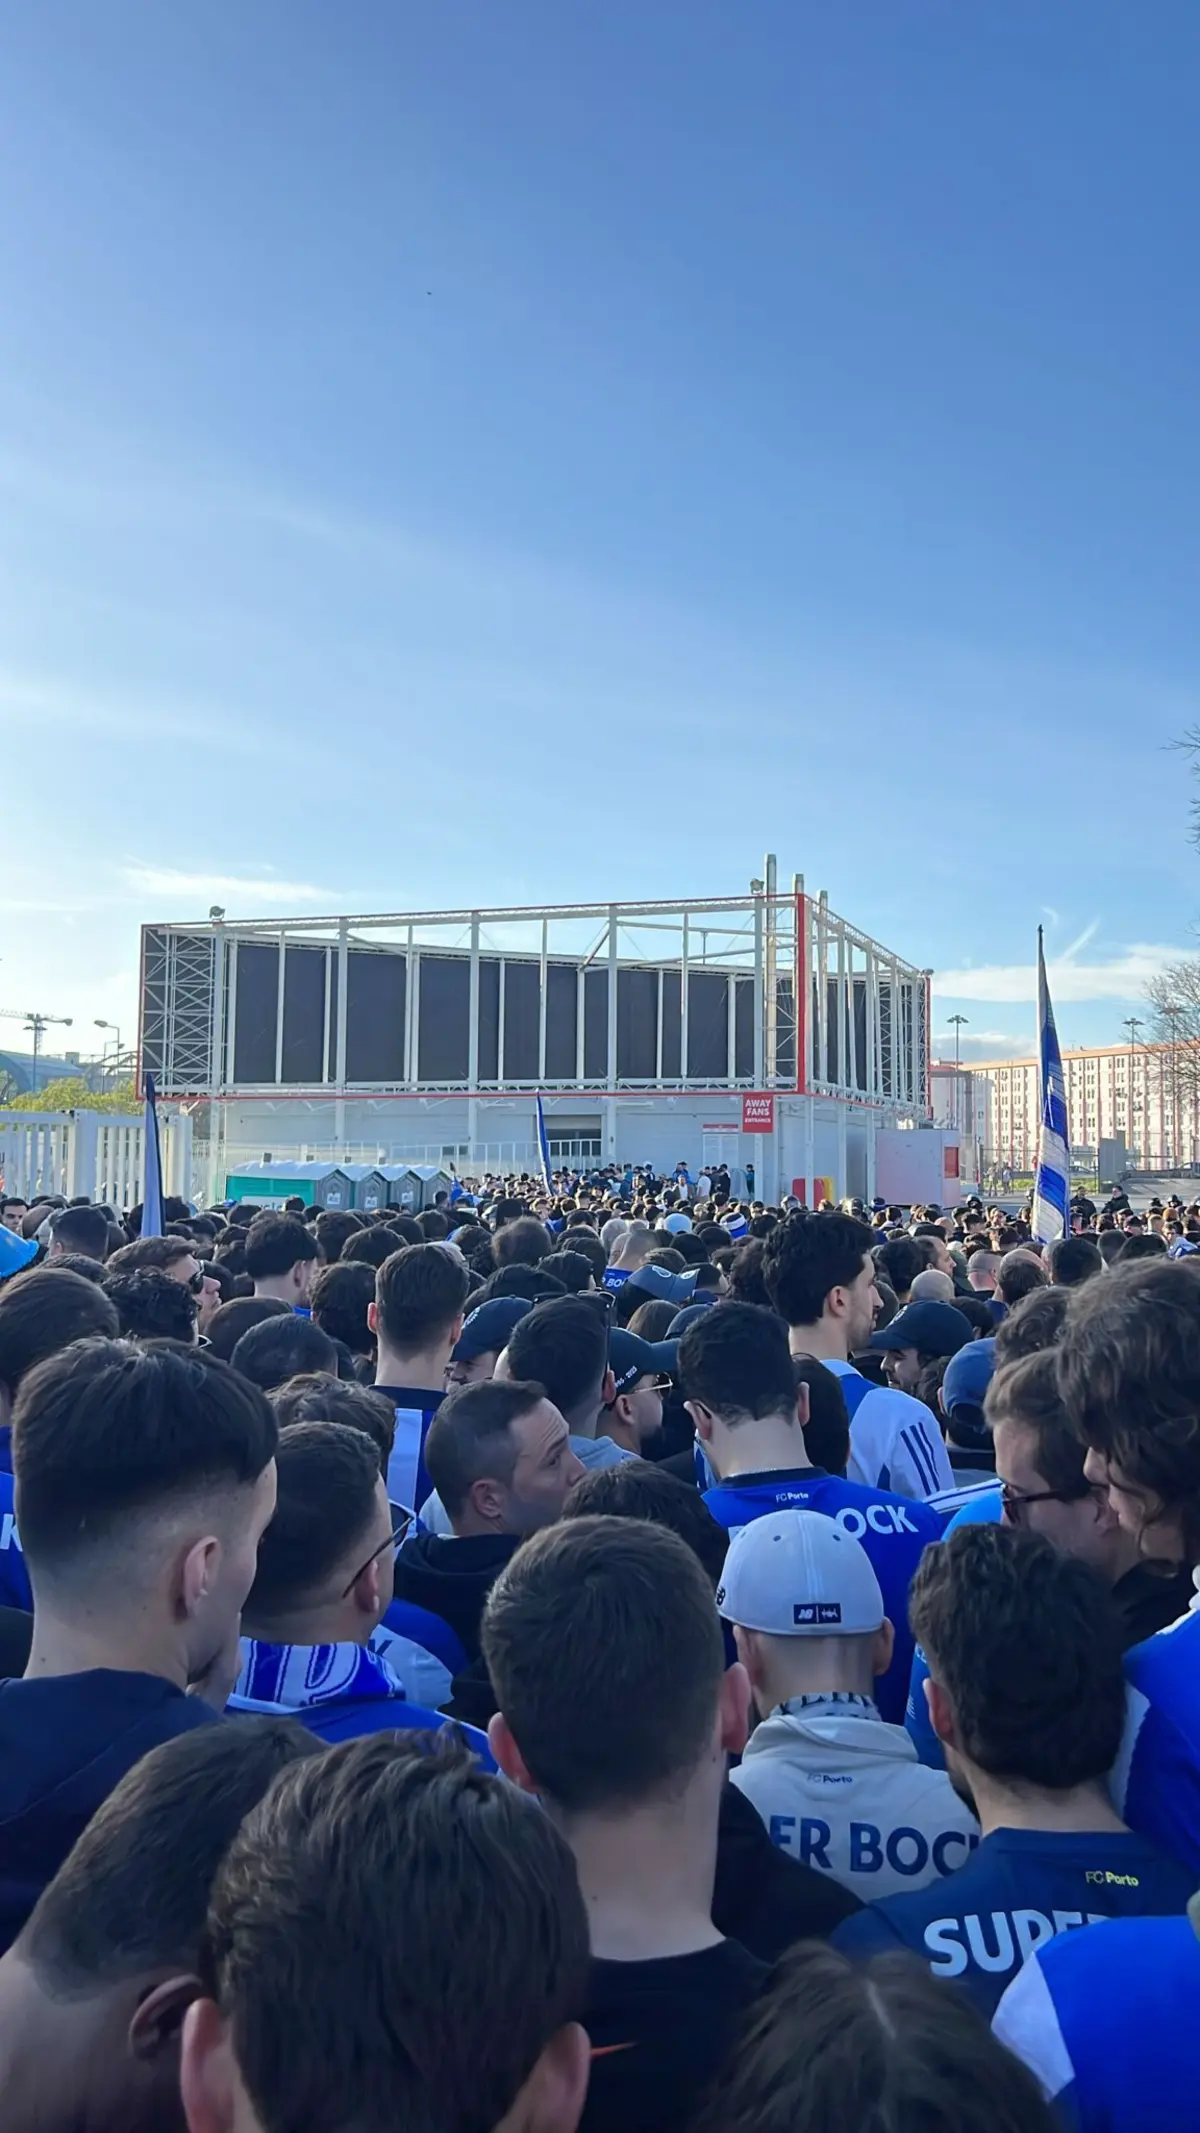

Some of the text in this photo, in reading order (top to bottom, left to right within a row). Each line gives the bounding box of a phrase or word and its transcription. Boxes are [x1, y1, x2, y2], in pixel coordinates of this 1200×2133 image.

[745, 1099, 771, 1107] AWAY
[746, 1107, 770, 1116] FANS
[776, 1494, 787, 1503] FC
[850, 1822, 980, 1877] BOC
[1085, 1871, 1139, 1887] FC Porto
